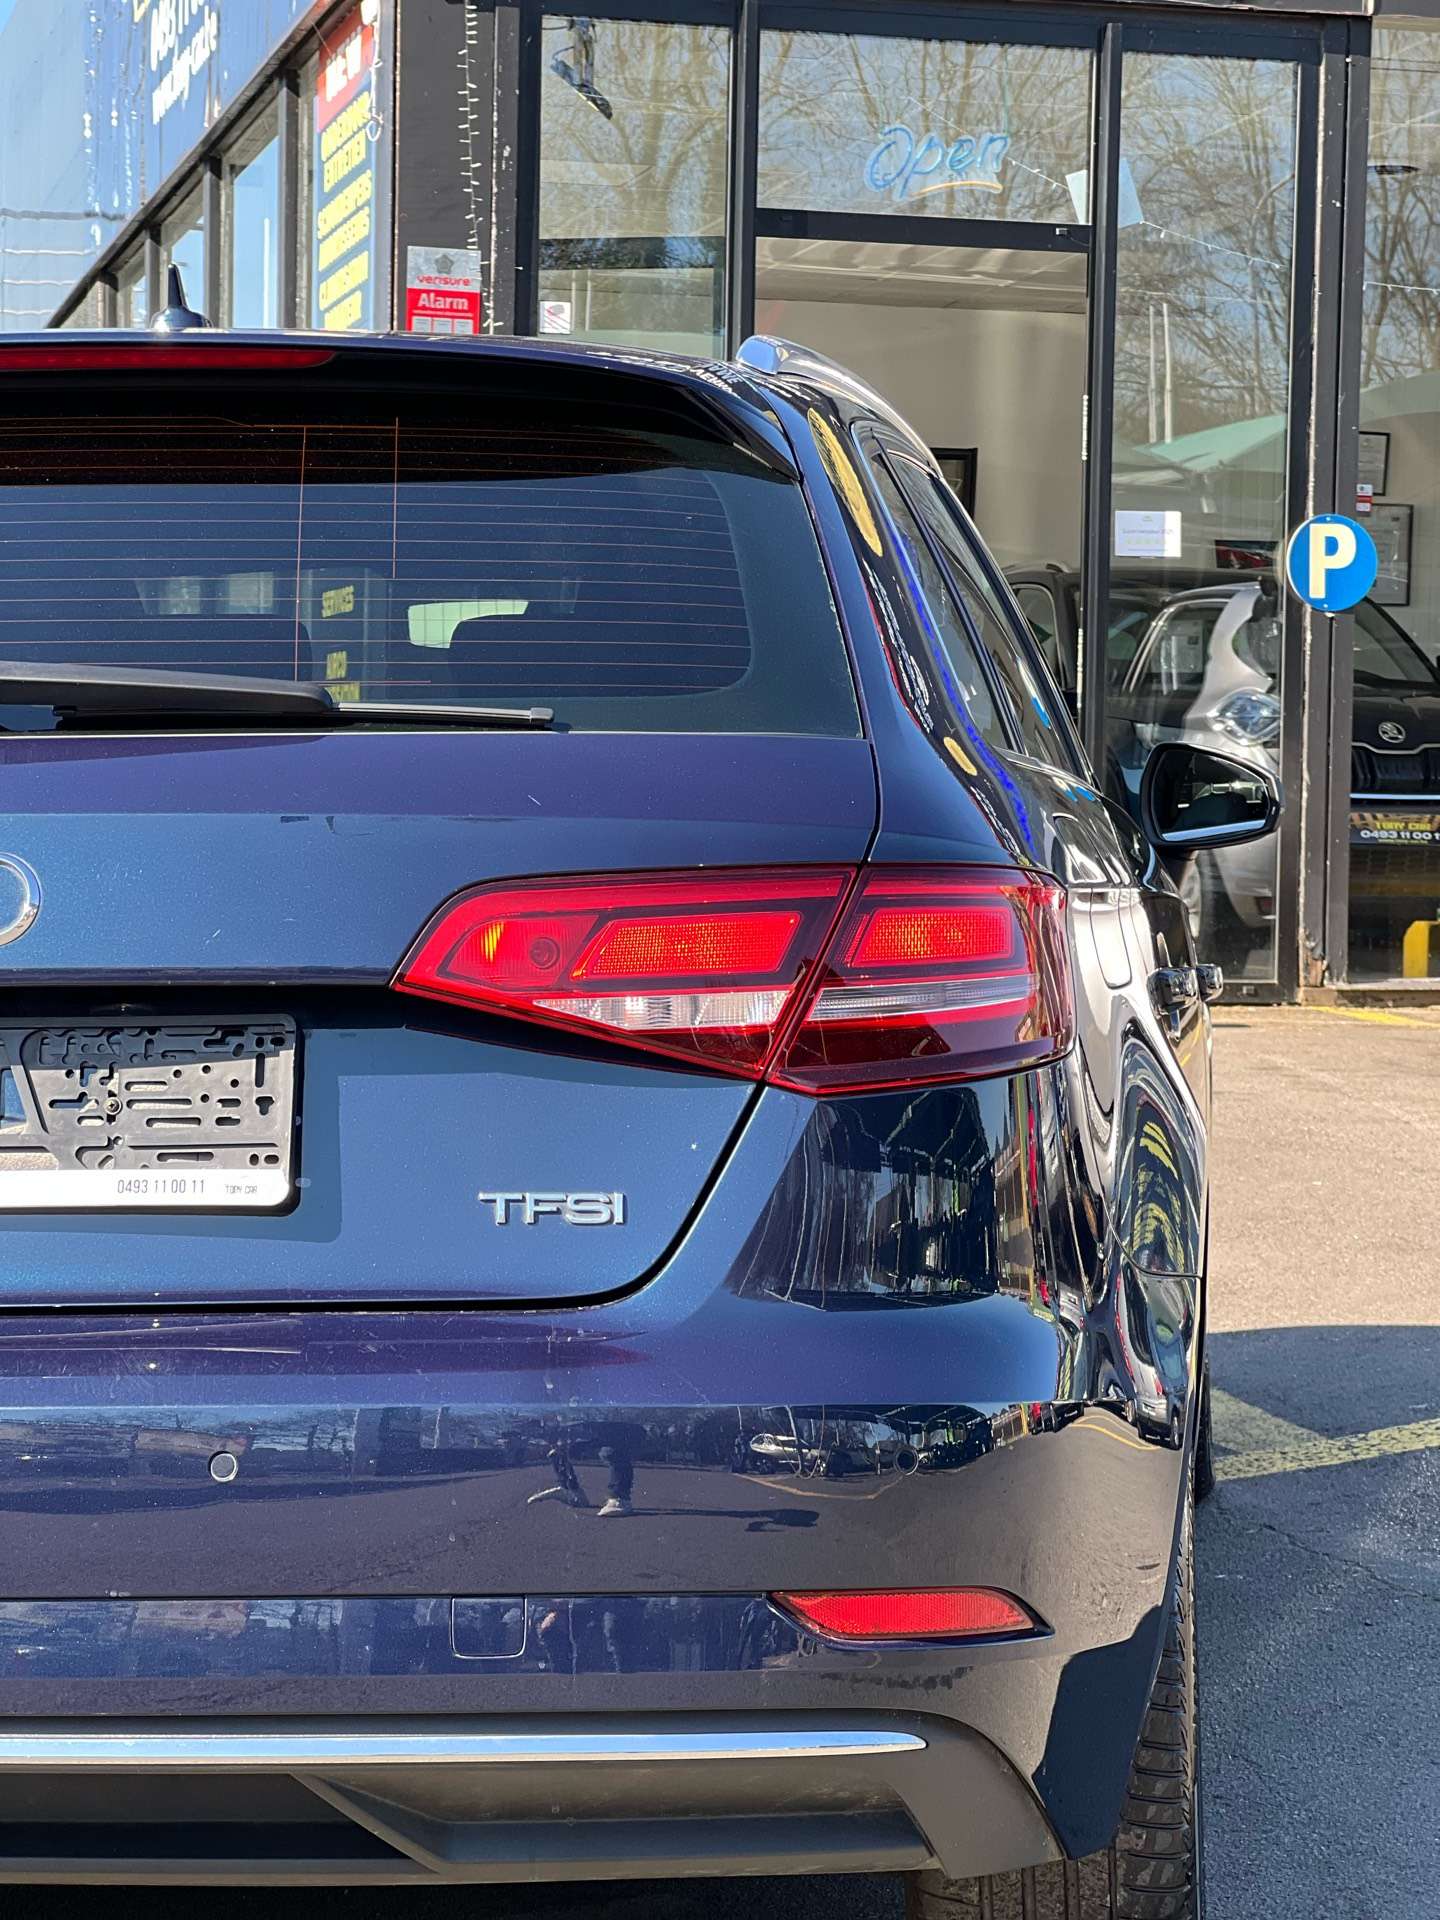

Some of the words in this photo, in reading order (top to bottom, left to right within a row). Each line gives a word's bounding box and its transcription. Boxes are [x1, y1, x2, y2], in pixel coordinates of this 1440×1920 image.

[864, 123, 1010, 201] Open
[416, 292, 469, 311] Alarm
[1308, 522, 1357, 599] P
[117, 1179, 148, 1193] 0493
[154, 1180, 166, 1193] 11
[171, 1179, 186, 1193] 00
[192, 1179, 205, 1193] 11
[478, 1191, 626, 1226] TFSI
